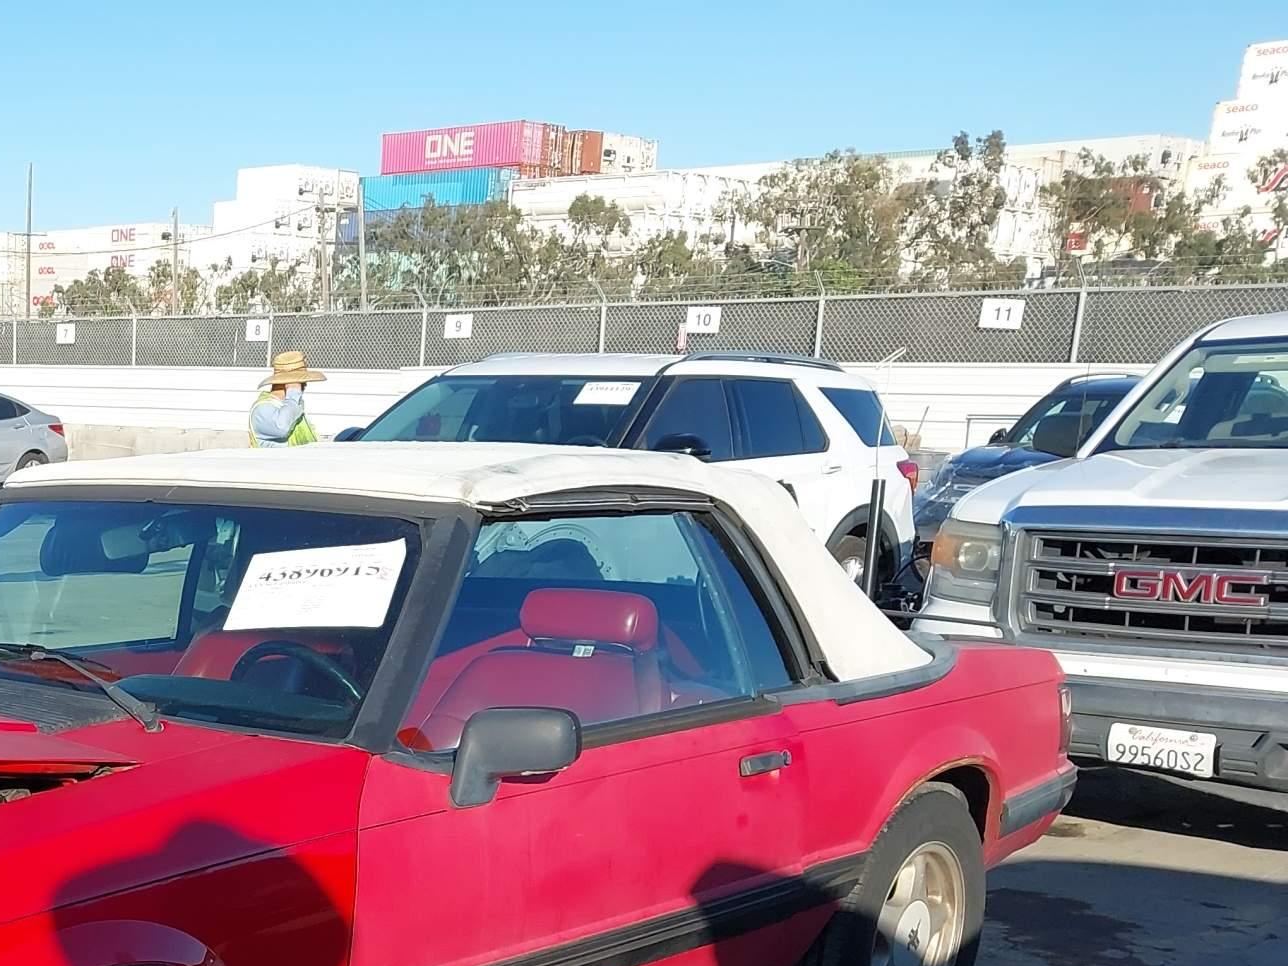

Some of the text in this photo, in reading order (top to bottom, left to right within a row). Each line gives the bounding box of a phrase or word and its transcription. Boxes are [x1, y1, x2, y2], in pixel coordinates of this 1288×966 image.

[1225, 104, 1259, 114] seaco
[425, 131, 474, 158] ONE
[1198, 161, 1230, 170] seaco
[111, 228, 136, 242] ONE
[110, 254, 135, 268] ONE
[696, 313, 711, 326] 10
[994, 306, 1012, 321] 11
[254, 325, 261, 336] 8
[455, 320, 462, 332] 9
[63, 329, 69, 338] 7
[1114, 570, 1266, 606] GMC
[1131, 729, 1190, 746] California
[1115, 743, 1205, 772] 99560S2
